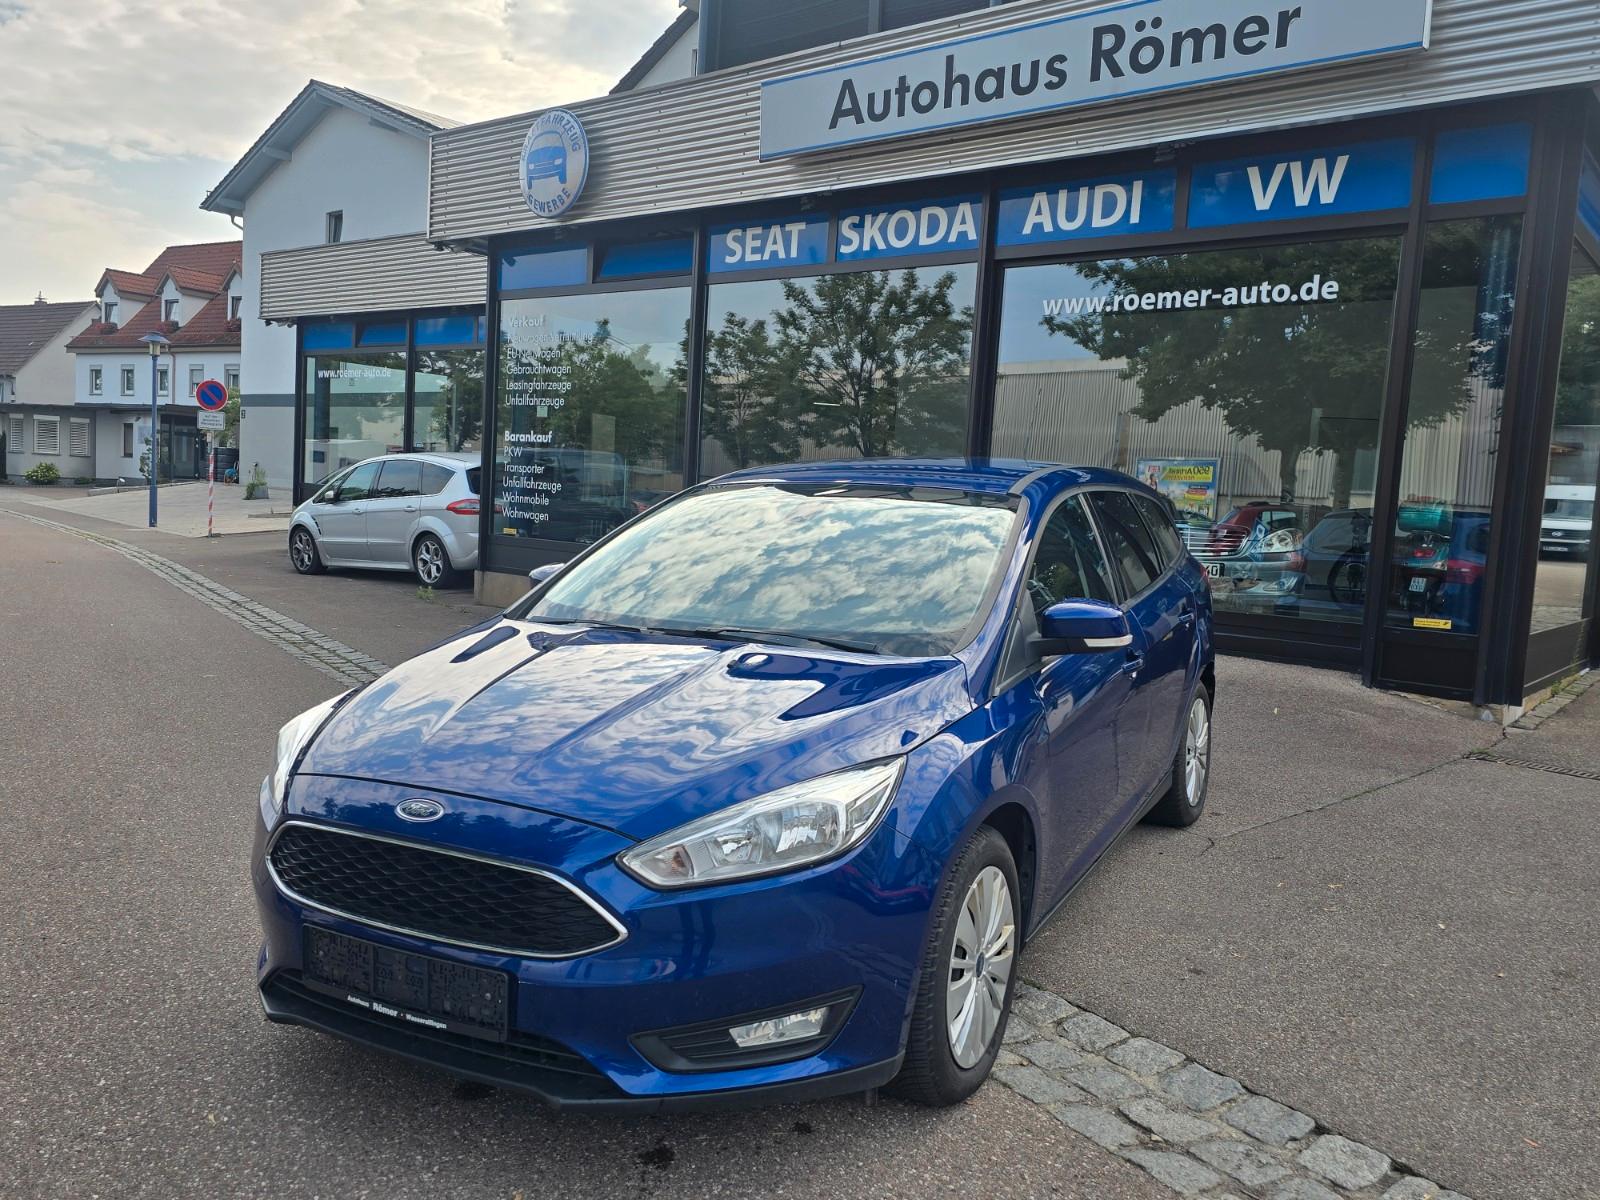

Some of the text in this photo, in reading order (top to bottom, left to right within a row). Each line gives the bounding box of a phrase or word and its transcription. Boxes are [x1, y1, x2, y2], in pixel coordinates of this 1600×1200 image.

[828, 6, 1302, 130] Autohaus Römer
[1246, 155, 1350, 211] VW
[527, 188, 571, 213] GEWERBE
[1022, 180, 1143, 235] AUDI
[840, 202, 977, 254] SKODA
[725, 222, 806, 263] SEAT
[1043, 274, 1339, 316] www.roemer-auto.de
[509, 315, 545, 328] Verkauf
[506, 363, 572, 377] Gebrauchtwagen
[505, 378, 572, 393] Leasingfahrzeuge
[505, 394, 565, 409] Unfallfahrzeuge
[504, 430, 552, 443] Barankauf
[503, 446, 523, 457] PKW
[503, 462, 545, 475] Transporter
[502, 476, 562, 493] Unfallfahrzeuge
[502, 491, 549, 506] Wohnmobile
[502, 506, 549, 523] Wohnwagen
[372, 1002, 398, 1017] Römer
